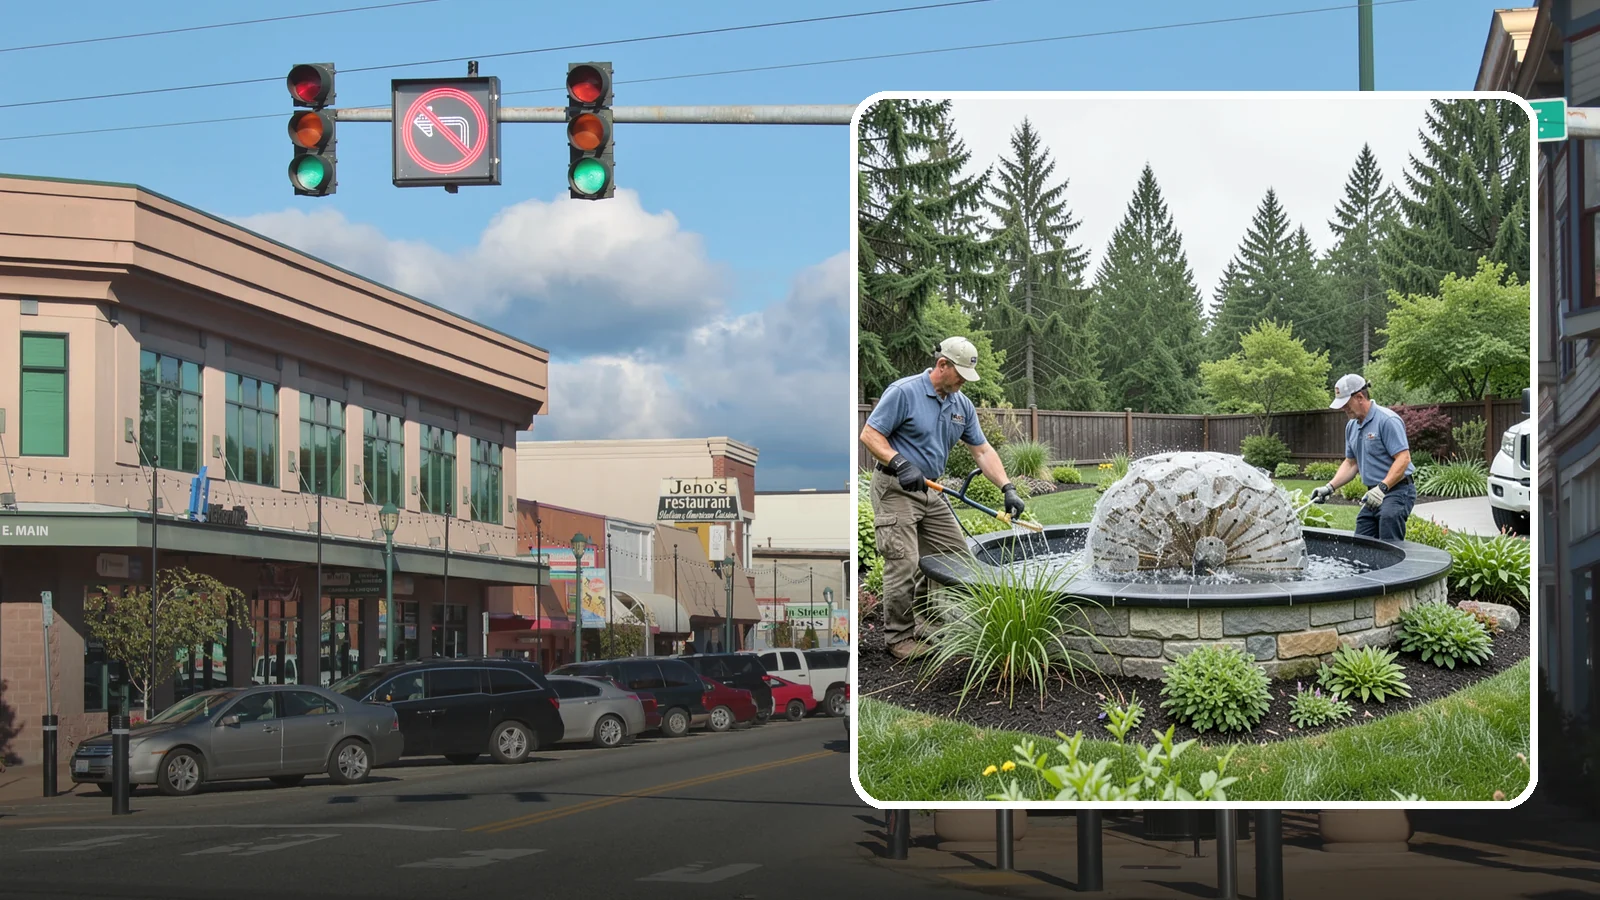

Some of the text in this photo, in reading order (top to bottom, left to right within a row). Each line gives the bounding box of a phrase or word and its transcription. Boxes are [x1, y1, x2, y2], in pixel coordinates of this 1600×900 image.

[670, 480, 727, 494] Jeno's
[665, 497, 731, 509] restaurant
[659, 510, 681, 519] Italian
[686, 510, 714, 519] American
[715, 510, 737, 519] Cuisine
[2, 525, 49, 536] E. MAIN
[798, 608, 829, 616] Street
